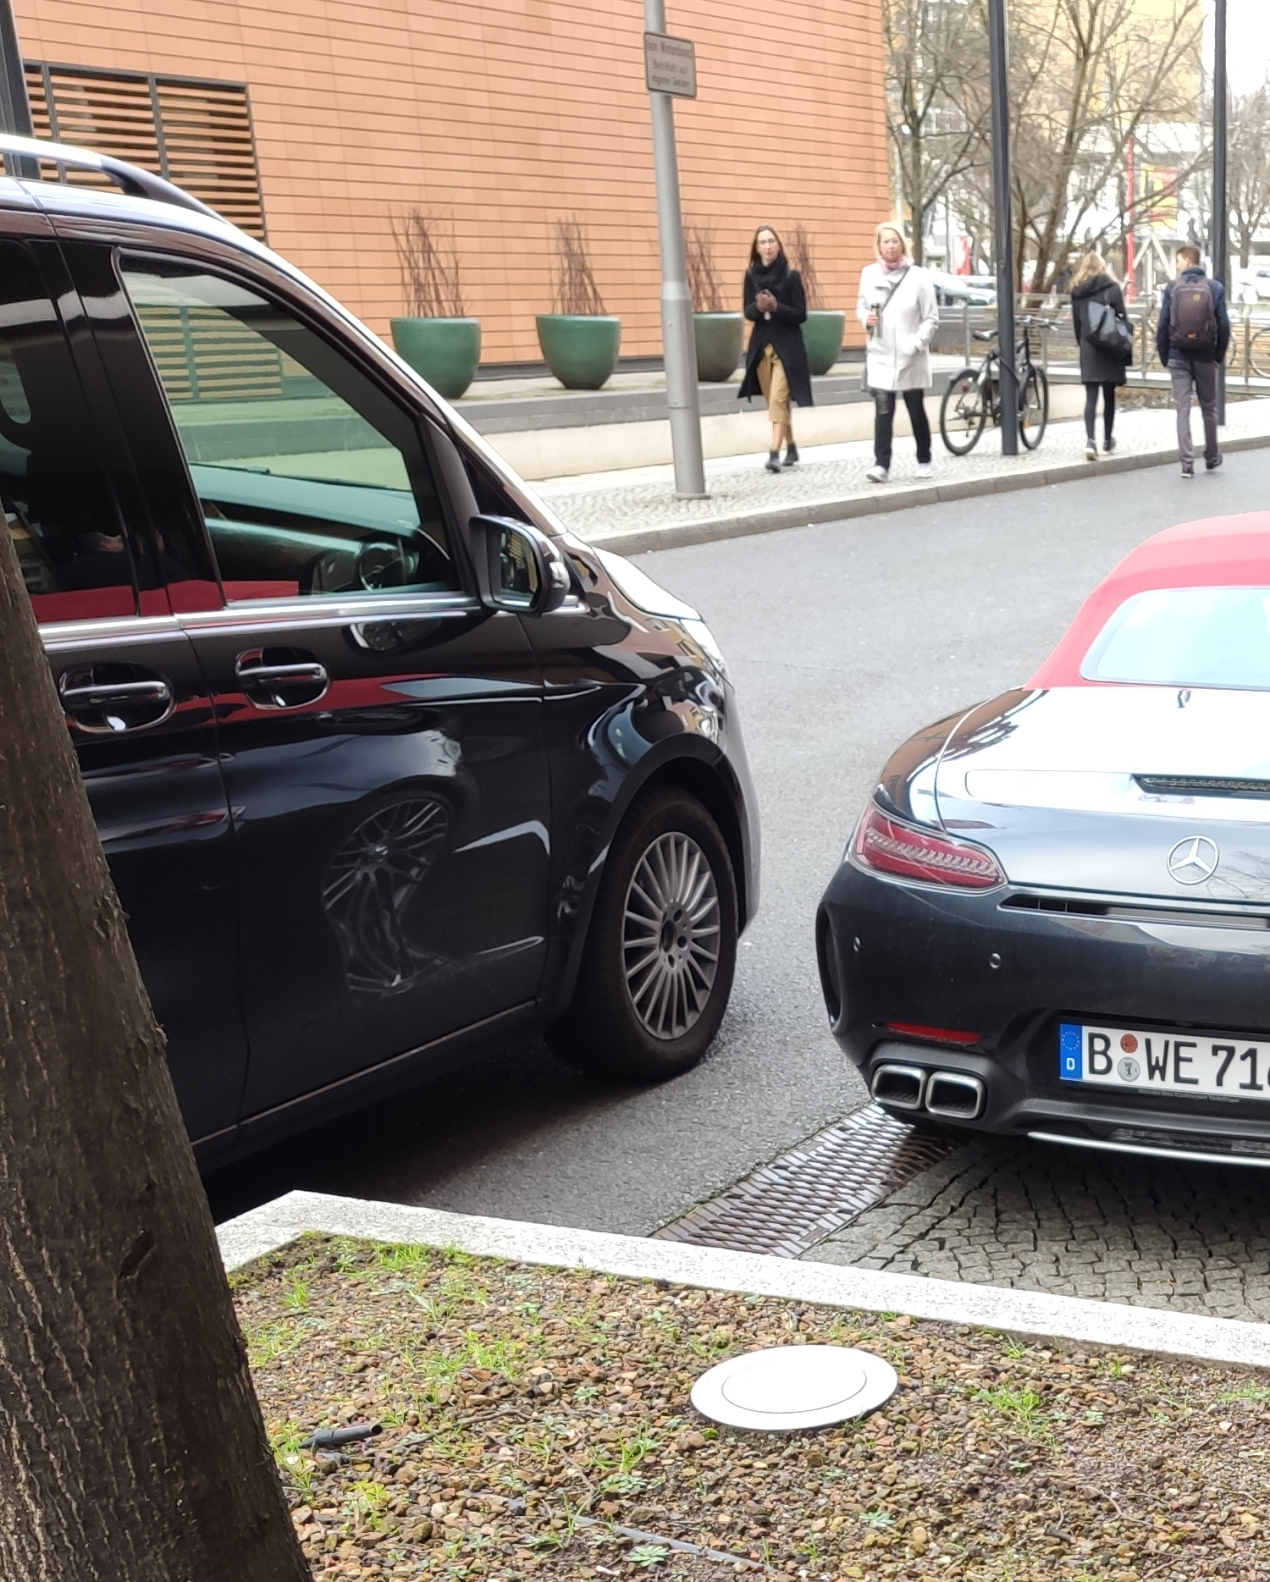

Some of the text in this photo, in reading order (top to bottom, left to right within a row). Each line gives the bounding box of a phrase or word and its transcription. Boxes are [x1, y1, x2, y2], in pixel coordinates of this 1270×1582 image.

[1066, 1057, 1075, 1070] D
[1088, 1032, 1113, 1075] B
[1144, 1038, 1199, 1085] WE
